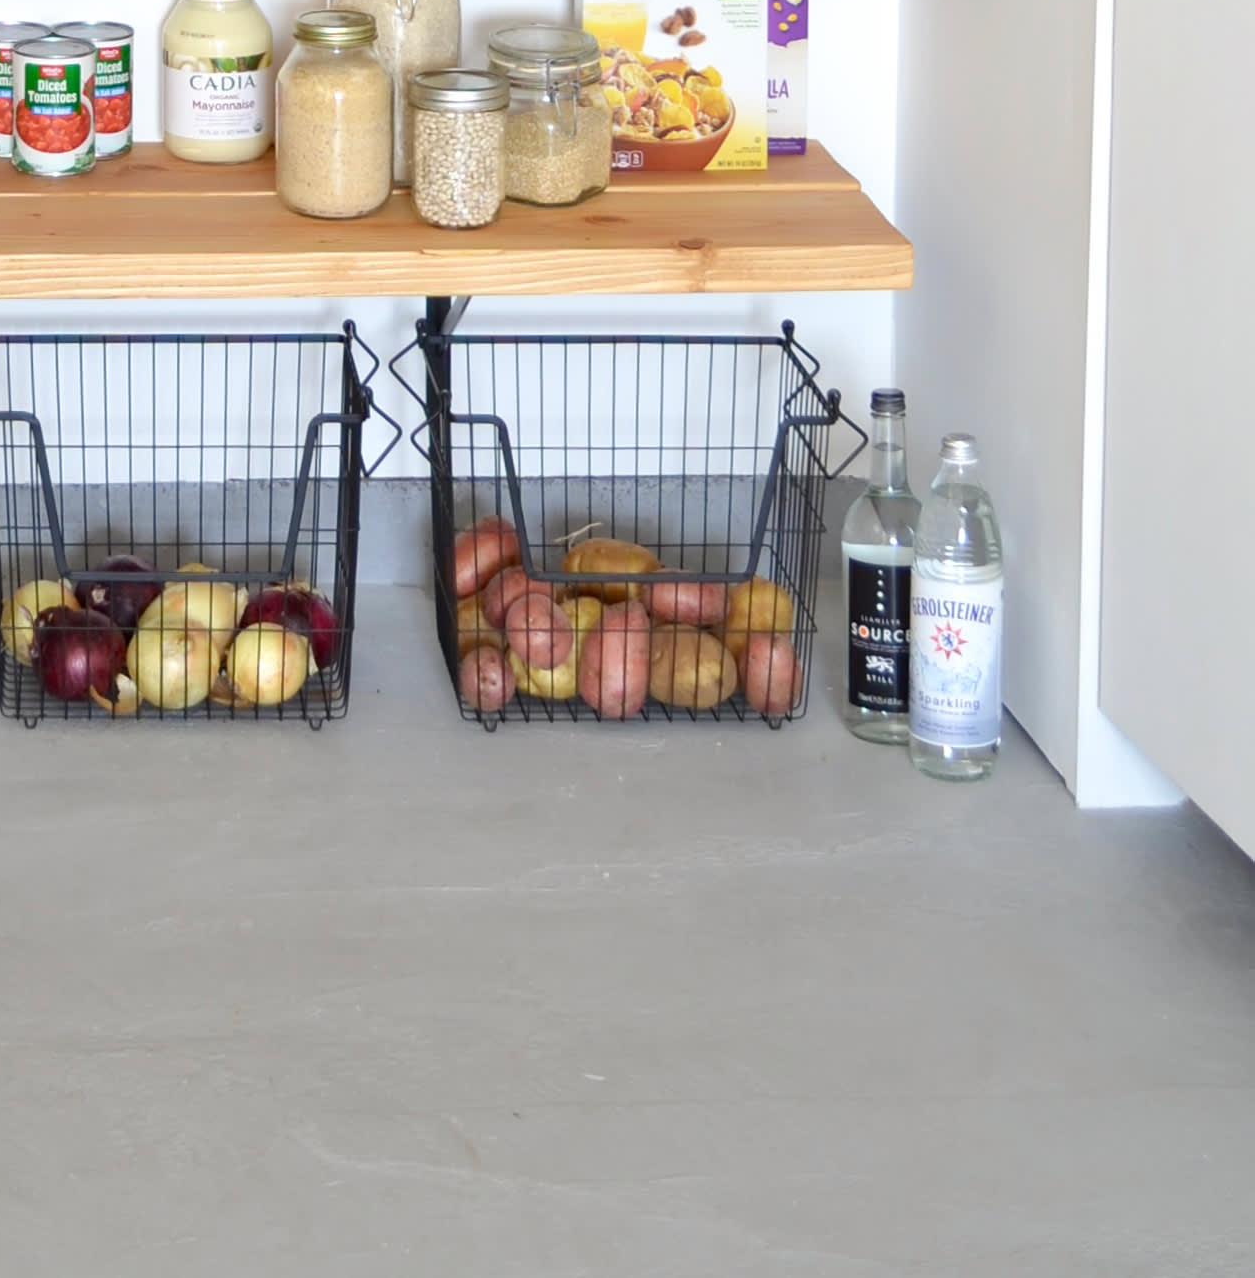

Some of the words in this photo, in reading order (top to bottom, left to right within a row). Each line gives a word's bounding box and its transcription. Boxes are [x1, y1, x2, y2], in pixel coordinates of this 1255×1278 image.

[37, 79, 67, 92] Diced
[189, 74, 256, 91] CADIA
[27, 91, 78, 104] Tomatoes
[192, 99, 256, 112] Mayonnaise
[918, 691, 981, 711] Sparkling
